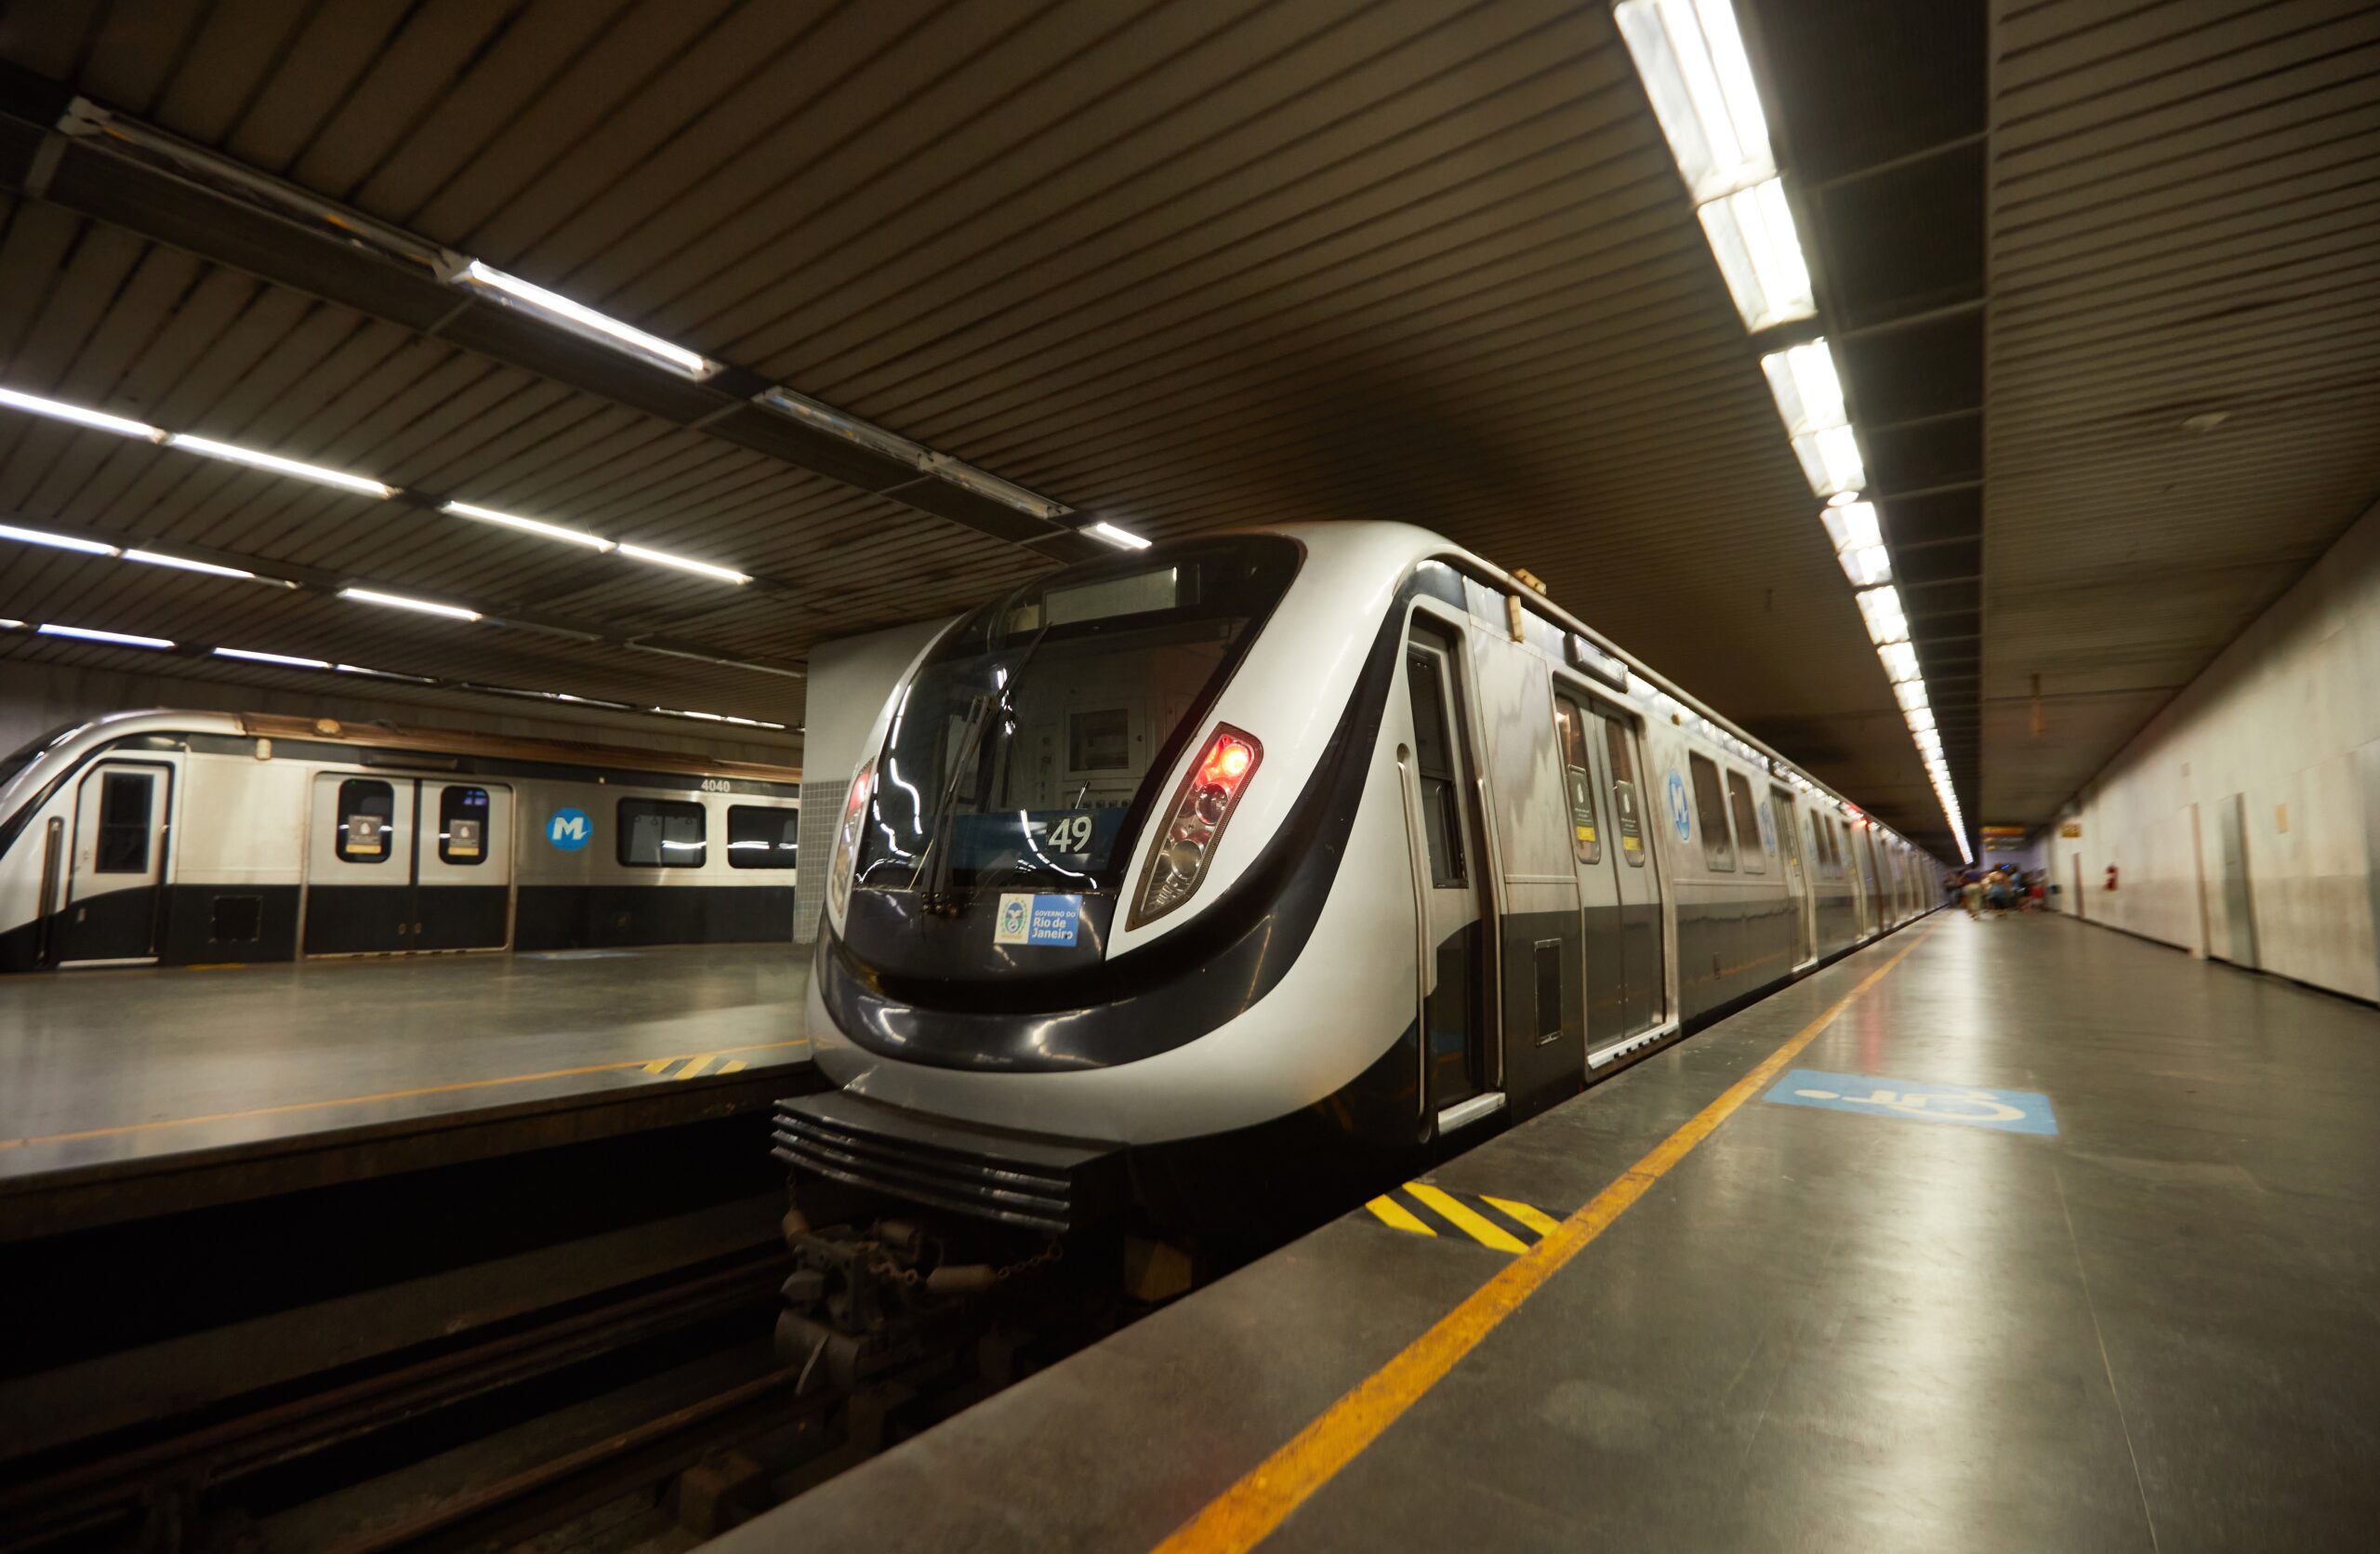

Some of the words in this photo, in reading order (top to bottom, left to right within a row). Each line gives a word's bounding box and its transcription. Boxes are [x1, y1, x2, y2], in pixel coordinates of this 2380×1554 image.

[701, 778, 731, 792] 4040
[1048, 816, 1092, 853] 49
[1033, 917, 1051, 928] Rio
[1051, 917, 1066, 929] de
[1031, 928, 1074, 940] Janeiro
